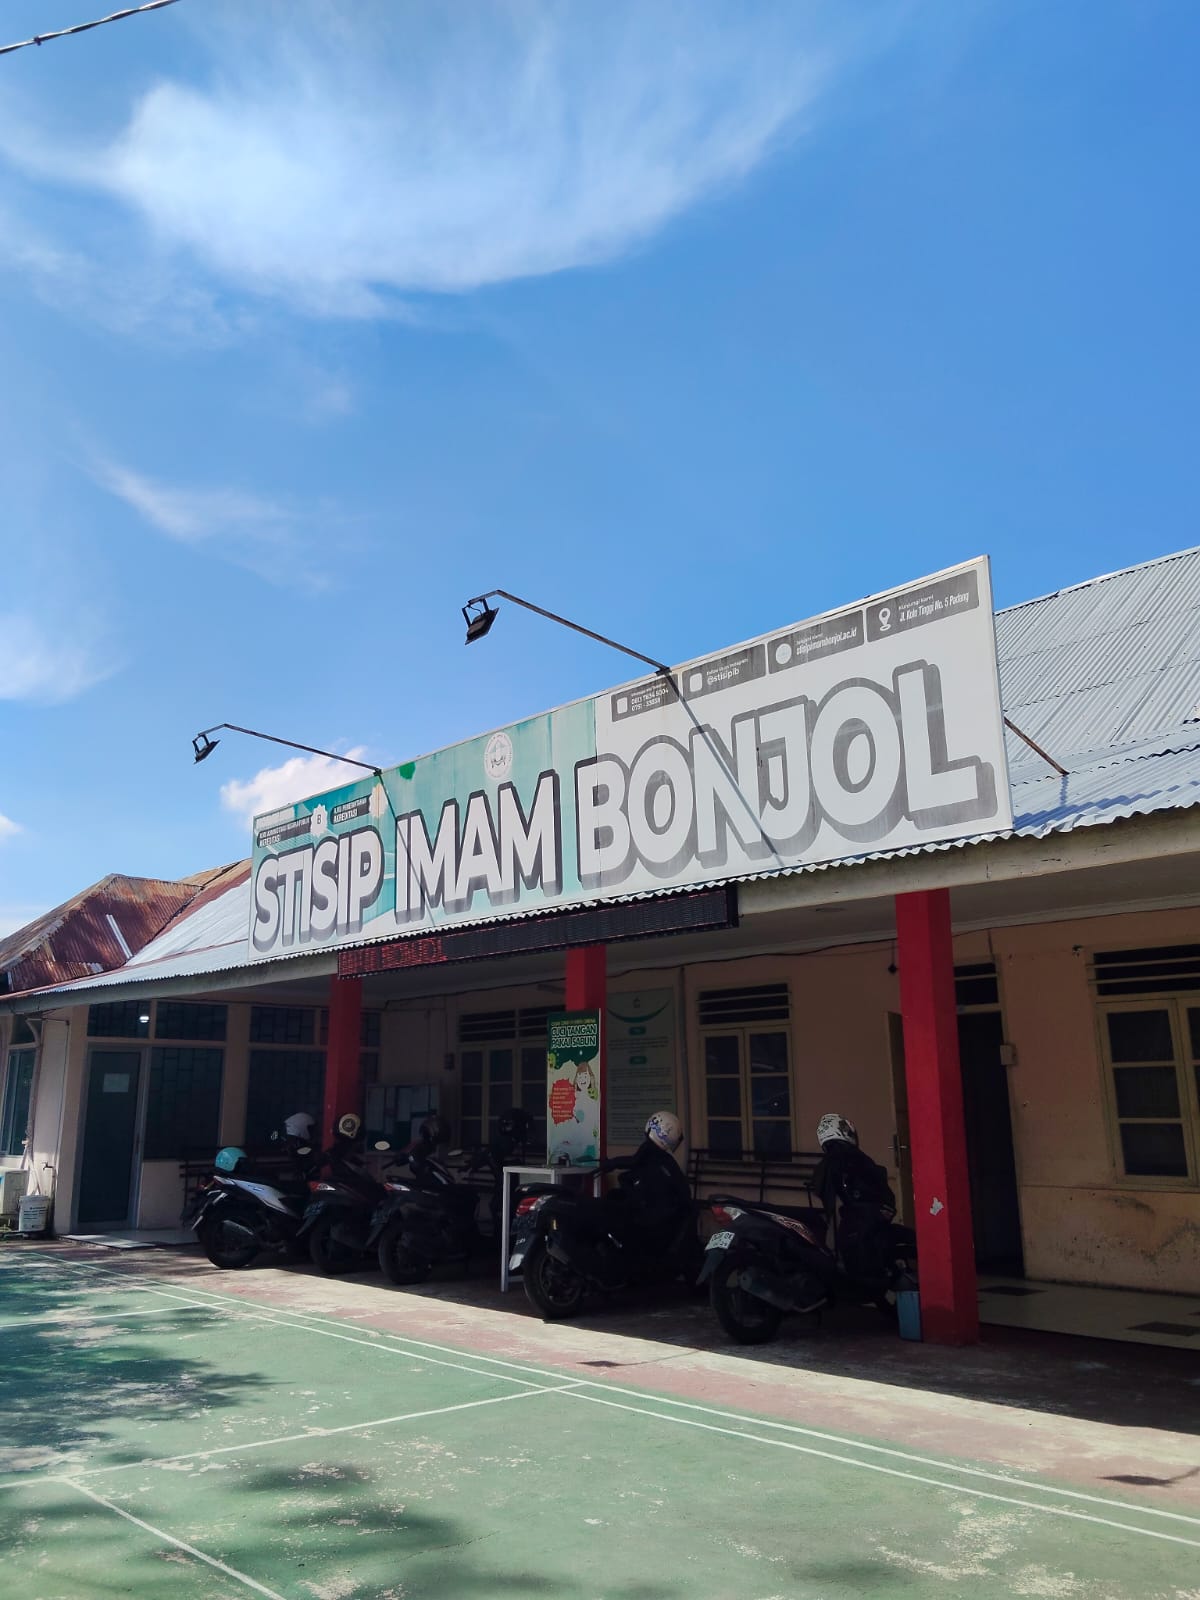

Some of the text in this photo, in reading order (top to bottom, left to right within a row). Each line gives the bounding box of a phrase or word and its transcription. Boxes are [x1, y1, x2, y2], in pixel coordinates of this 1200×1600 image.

[918, 604, 934, 619] Tinggi
[935, 600, 944, 611] No.
[949, 591, 969, 606] Padang
[707, 668, 740, 686] @stisipib
[252, 659, 998, 952] STISIP IMAM BONJOL
[552, 1024, 597, 1037] CUCI TANGAN
[552, 1037, 571, 1048] PAKAI
[572, 1036, 596, 1047] SABUN
